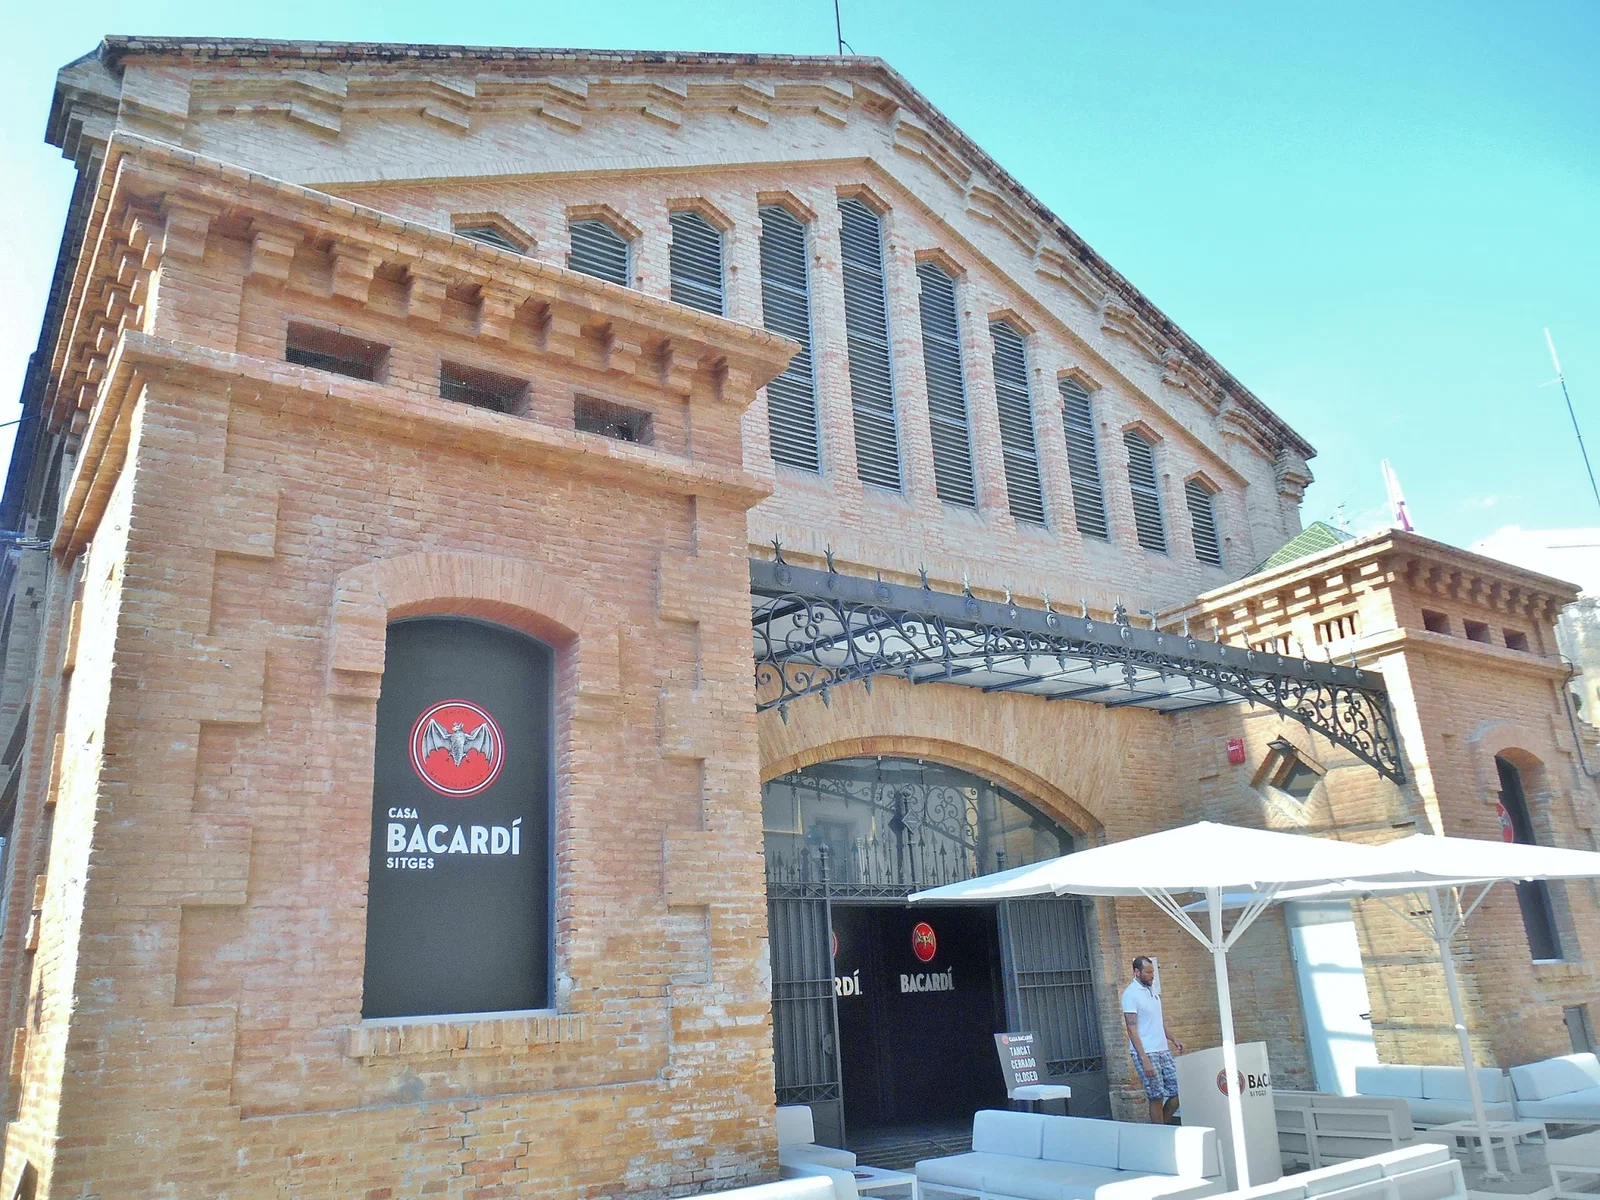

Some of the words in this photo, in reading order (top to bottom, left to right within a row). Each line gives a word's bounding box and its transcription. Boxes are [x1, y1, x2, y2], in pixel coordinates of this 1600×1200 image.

[388, 807, 418, 819] CASA
[387, 817, 522, 855] BACARDÍ
[386, 857, 435, 869] SITGES
[1009, 1046, 1031, 1056] TANCAT
[1011, 1058, 1036, 1069] CERRADO
[1015, 1071, 1038, 1082] CLOSED
